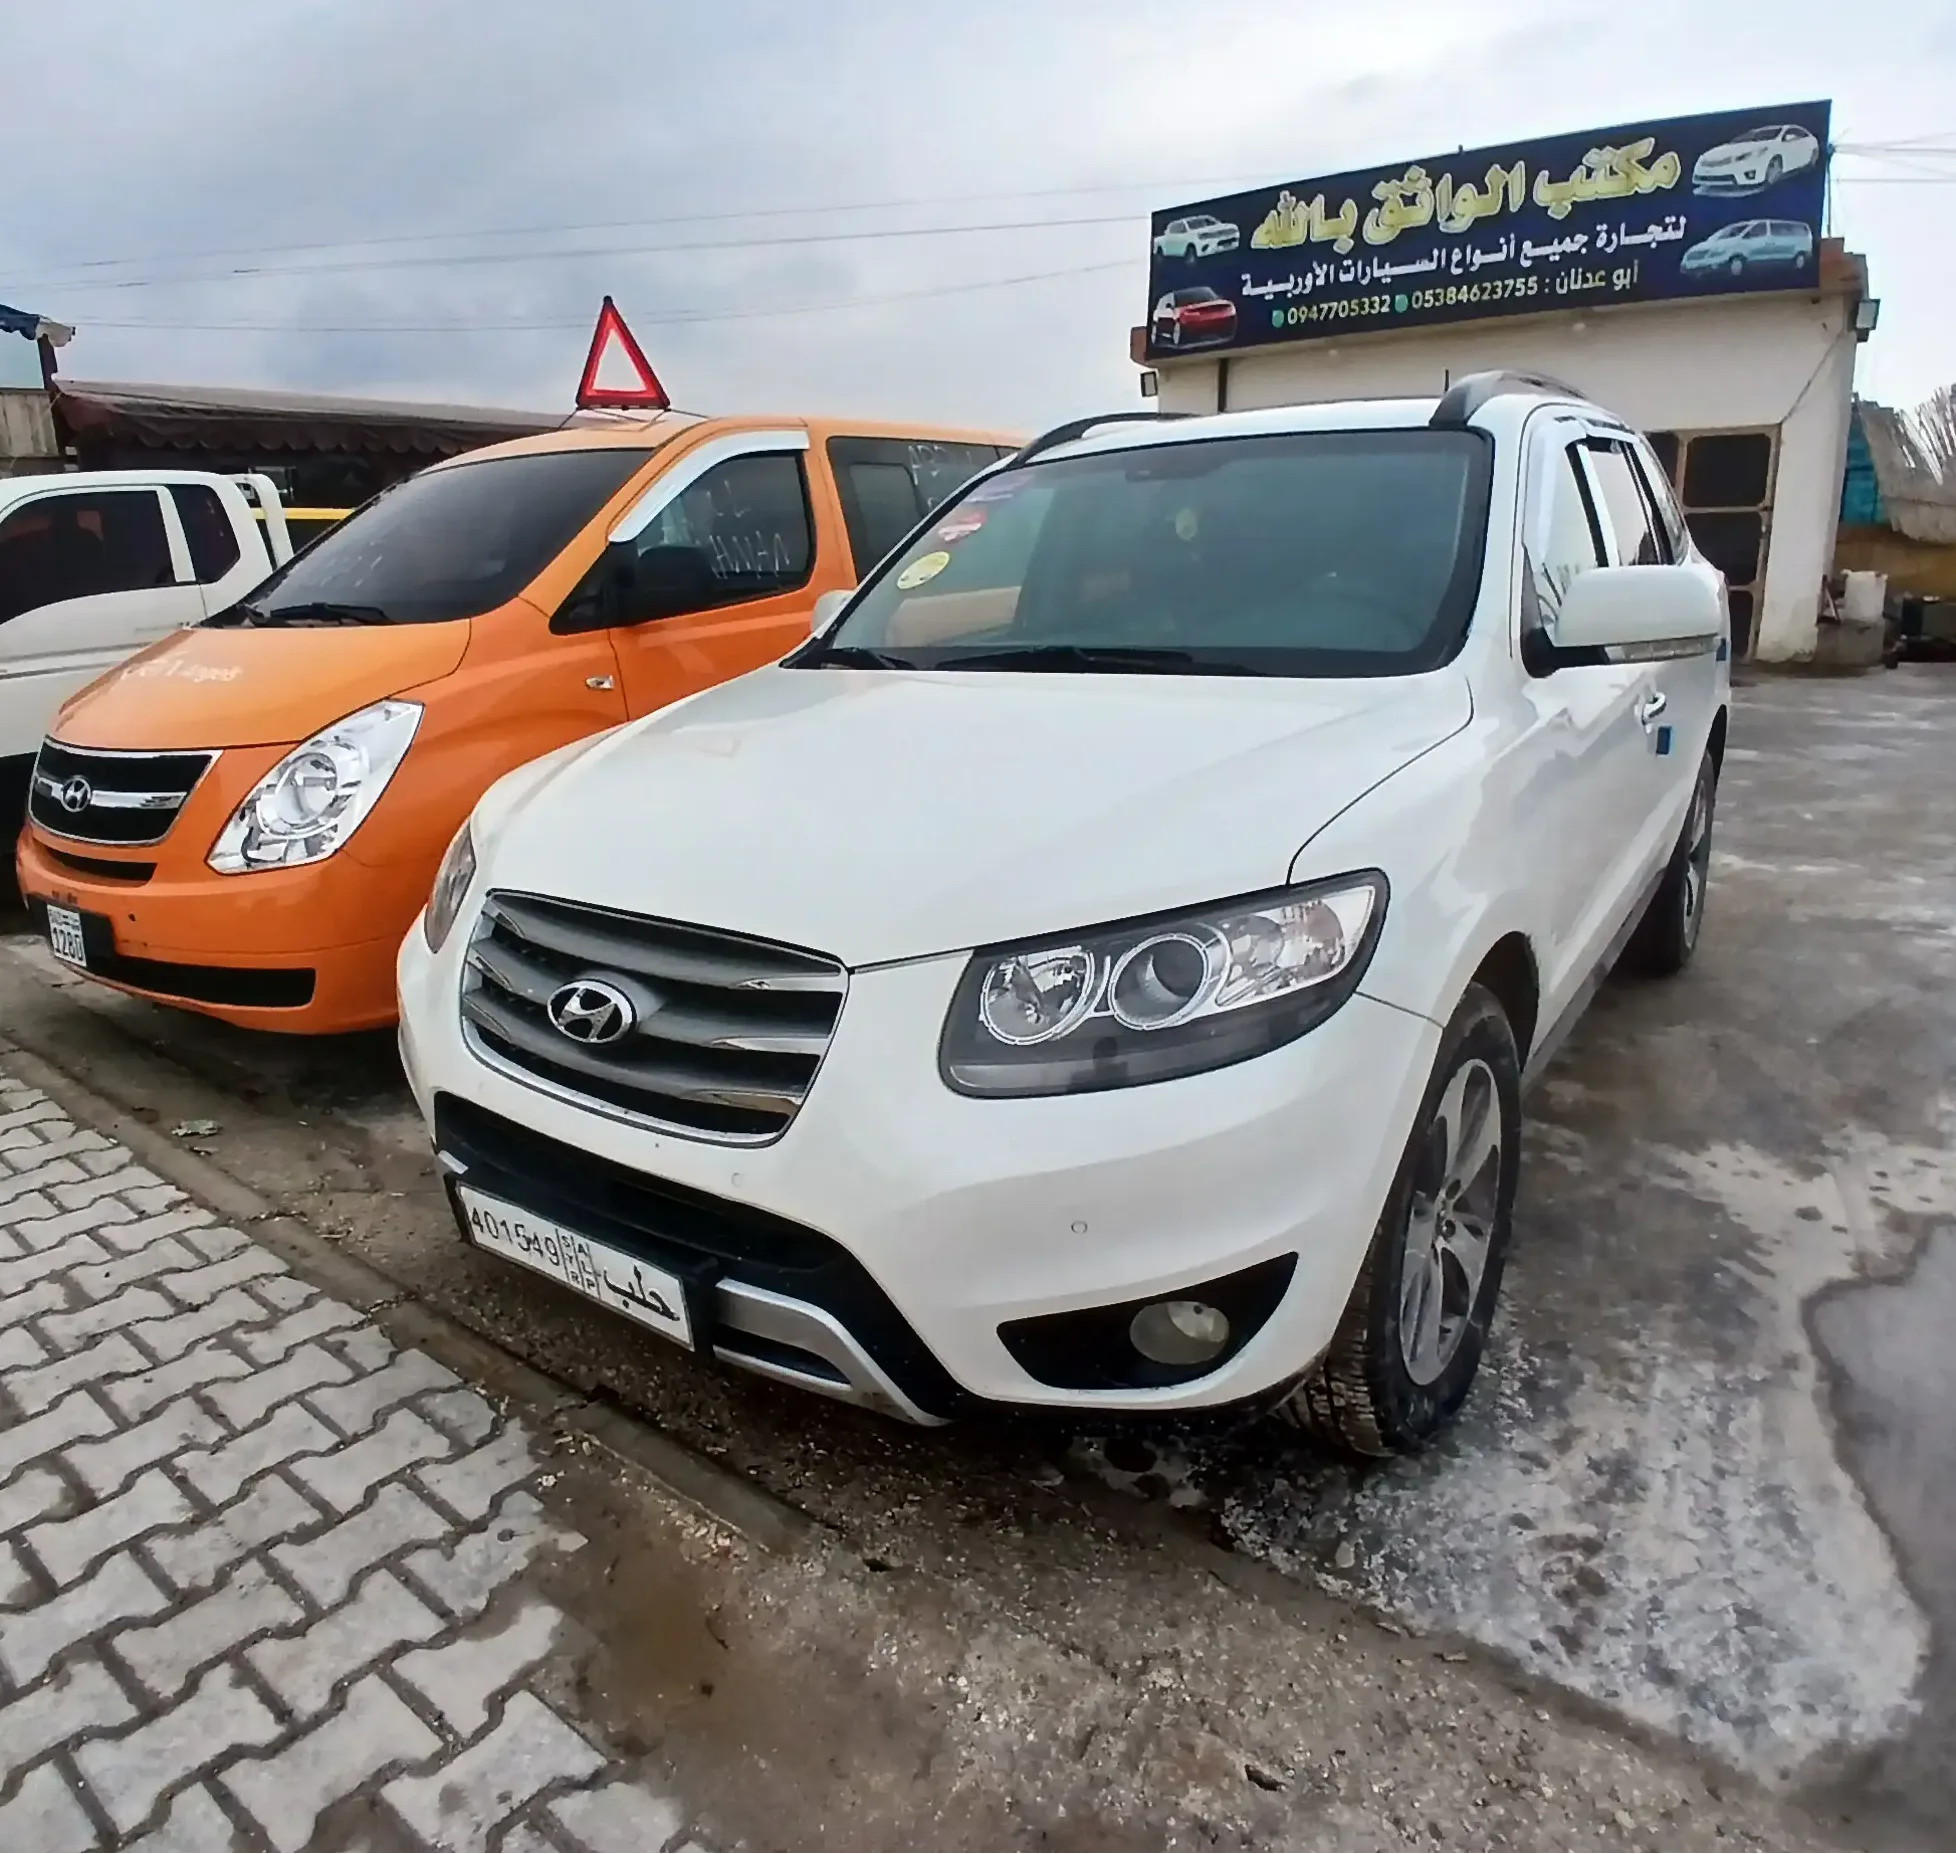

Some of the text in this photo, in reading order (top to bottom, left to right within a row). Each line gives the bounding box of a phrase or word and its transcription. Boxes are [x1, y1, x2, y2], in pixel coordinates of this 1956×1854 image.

[1250, 137, 1681, 254] مكتب الواثق بالله
[1519, 230, 1589, 267] جميع
[1595, 215, 1687, 253] لتجارة
[1339, 248, 1445, 286] السيارات
[1451, 233, 1516, 275] أنواع
[1411, 275, 1538, 309] 05384623755
[1555, 268, 1606, 294] عدنان
[1287, 295, 1391, 325] 0947705332
[53, 927, 84, 961] 1280
[472, 1207, 560, 1266] 401549
[576, 1243, 595, 1289] ALP
[603, 1264, 681, 1321] حلب
